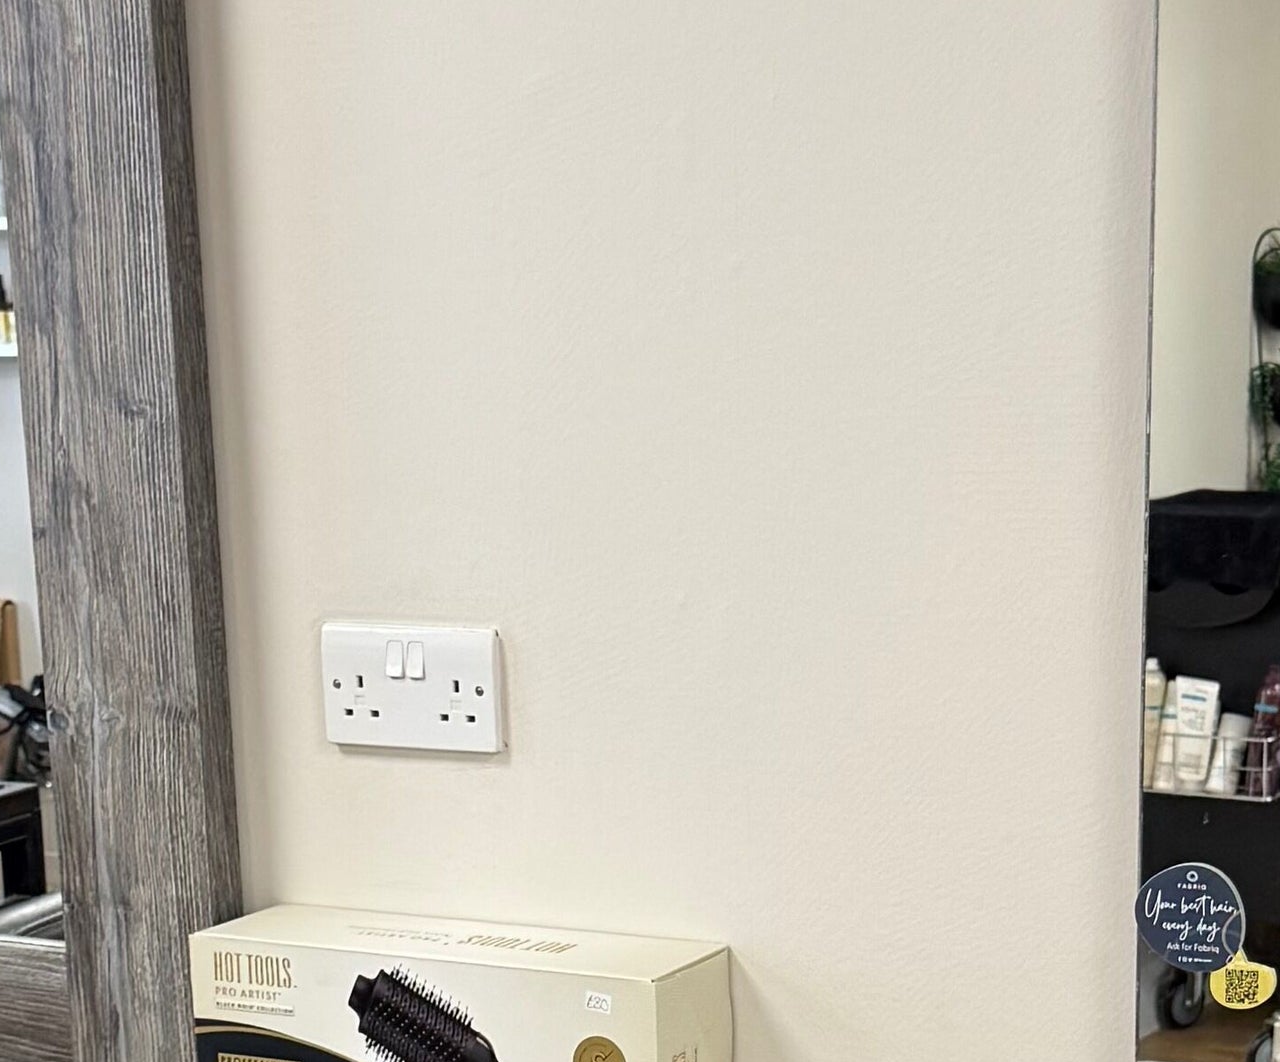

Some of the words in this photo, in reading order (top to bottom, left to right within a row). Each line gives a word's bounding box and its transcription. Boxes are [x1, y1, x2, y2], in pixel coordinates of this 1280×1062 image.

[1144, 888, 1177, 926] Your
[213, 951, 242, 984] HOT
[245, 953, 292, 989] TOOLS
[215, 986, 237, 997] PRO
[240, 989, 277, 1001] ARTIST
